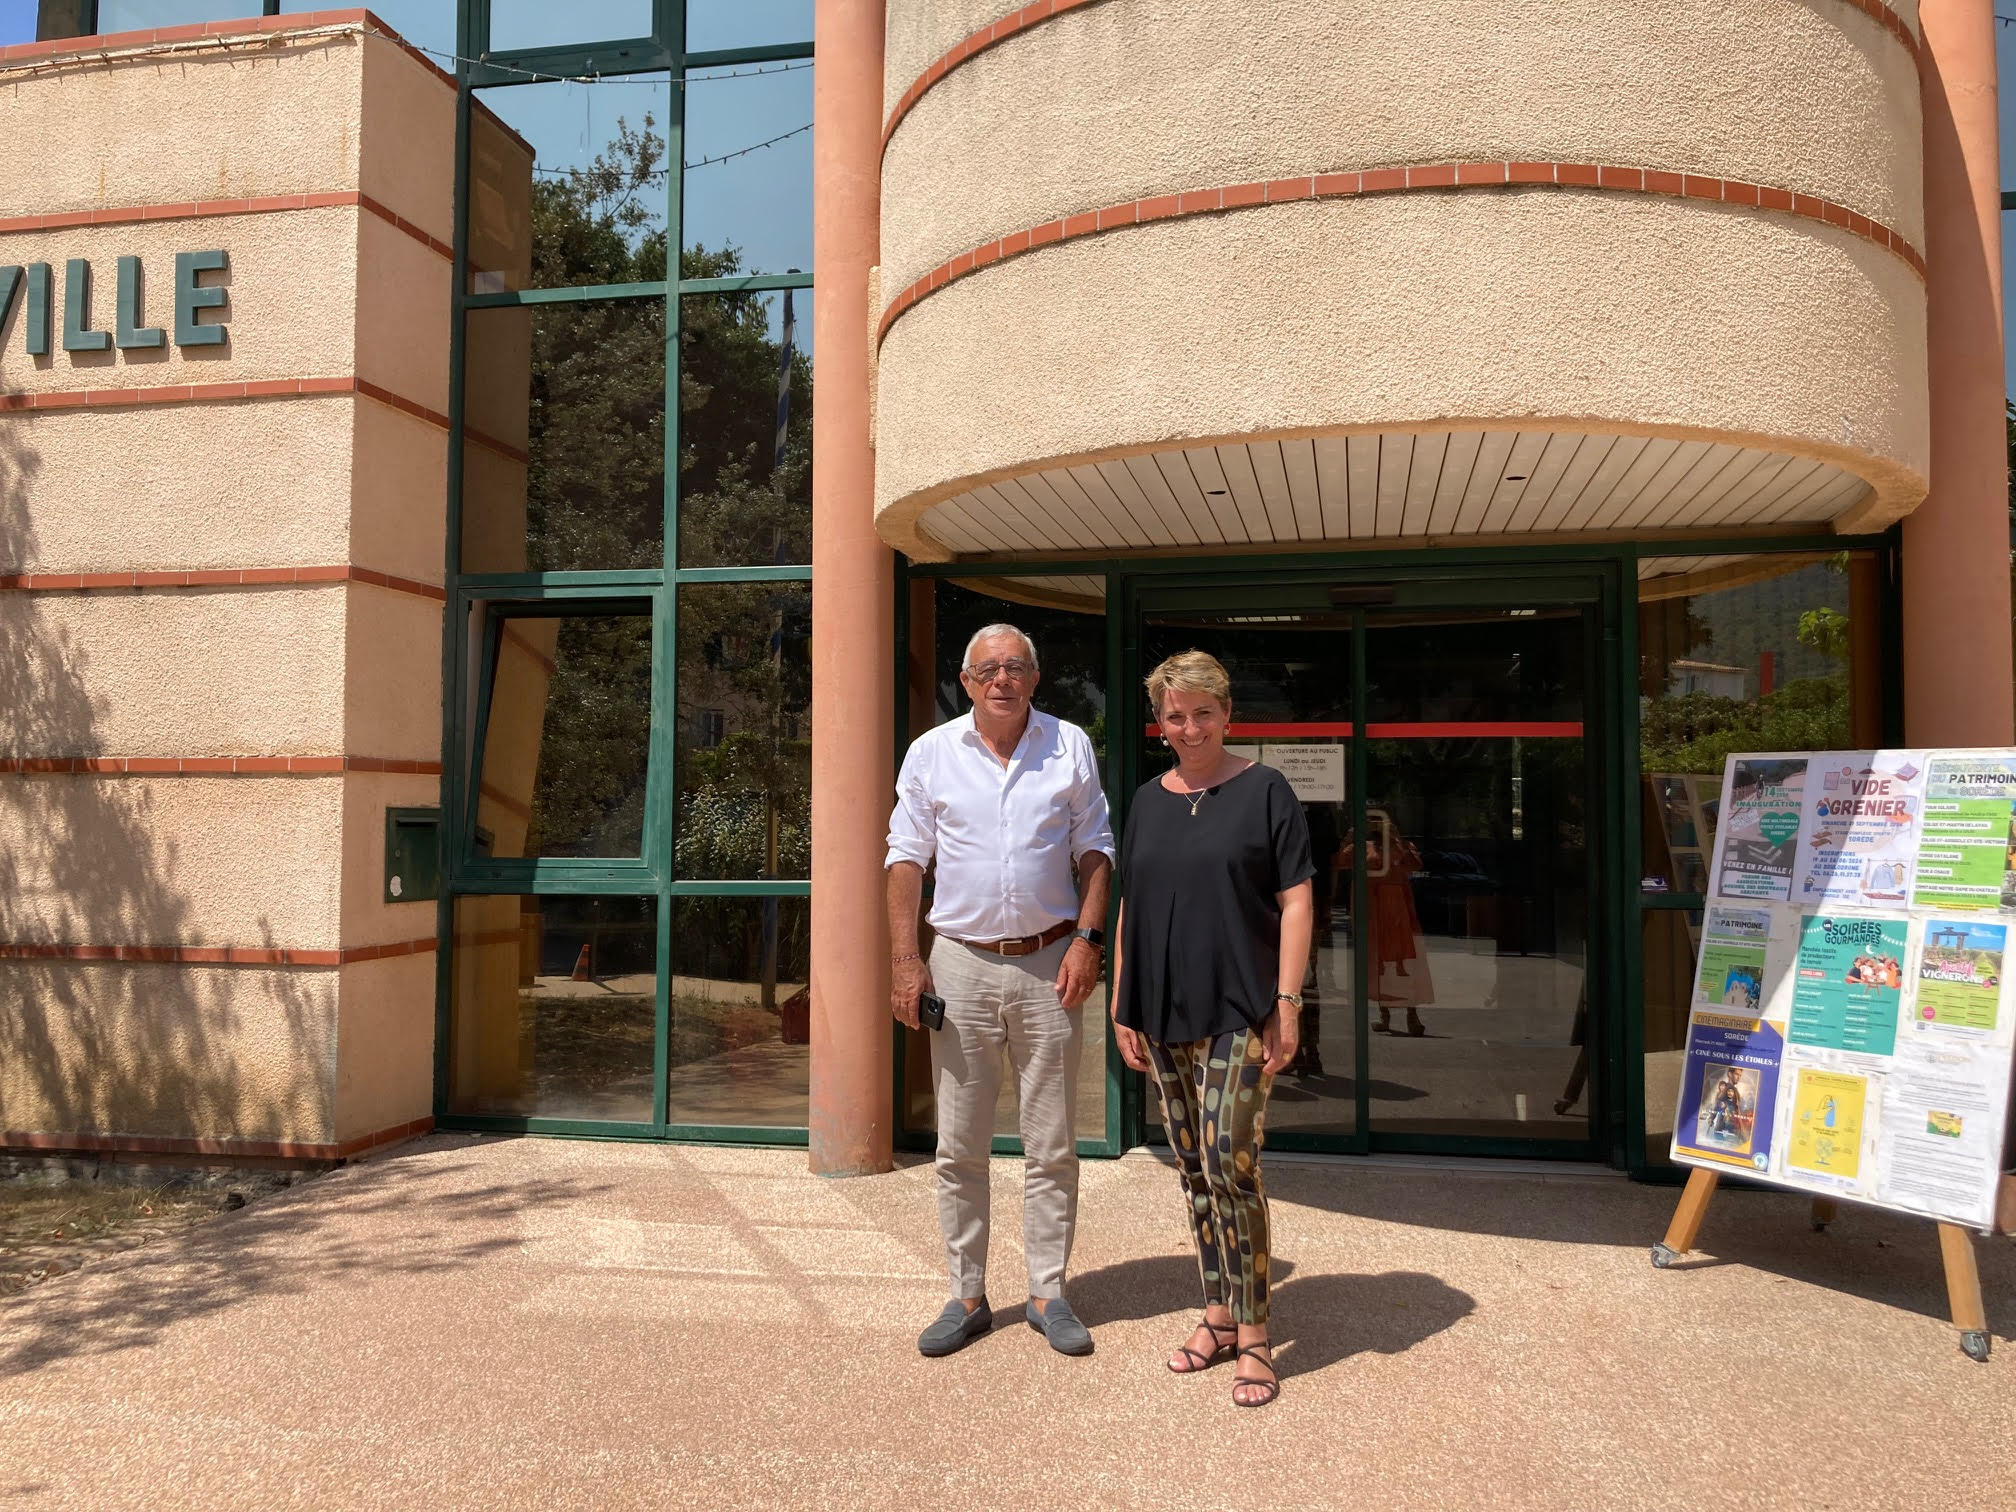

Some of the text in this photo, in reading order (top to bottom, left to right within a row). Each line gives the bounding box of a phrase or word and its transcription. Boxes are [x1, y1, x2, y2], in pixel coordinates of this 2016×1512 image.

[1765, 786, 1776, 798] 14
[1851, 779, 1891, 796] VIDE
[1829, 799, 1907, 816] GRENIER
[1723, 861, 1745, 869] VENEZ
[1746, 863, 1756, 871] EN
[1757, 864, 1787, 874] FAMILLE
[1720, 919, 1764, 929] PATRIMOINE
[1831, 919, 1882, 936] SOIRÉES
[1824, 932, 1881, 945] GOURMANDES
[1922, 968, 1985, 984] VIGNERONS
[1712, 1050, 1730, 1060] SOUS
[1731, 1053, 1744, 1062] LES
